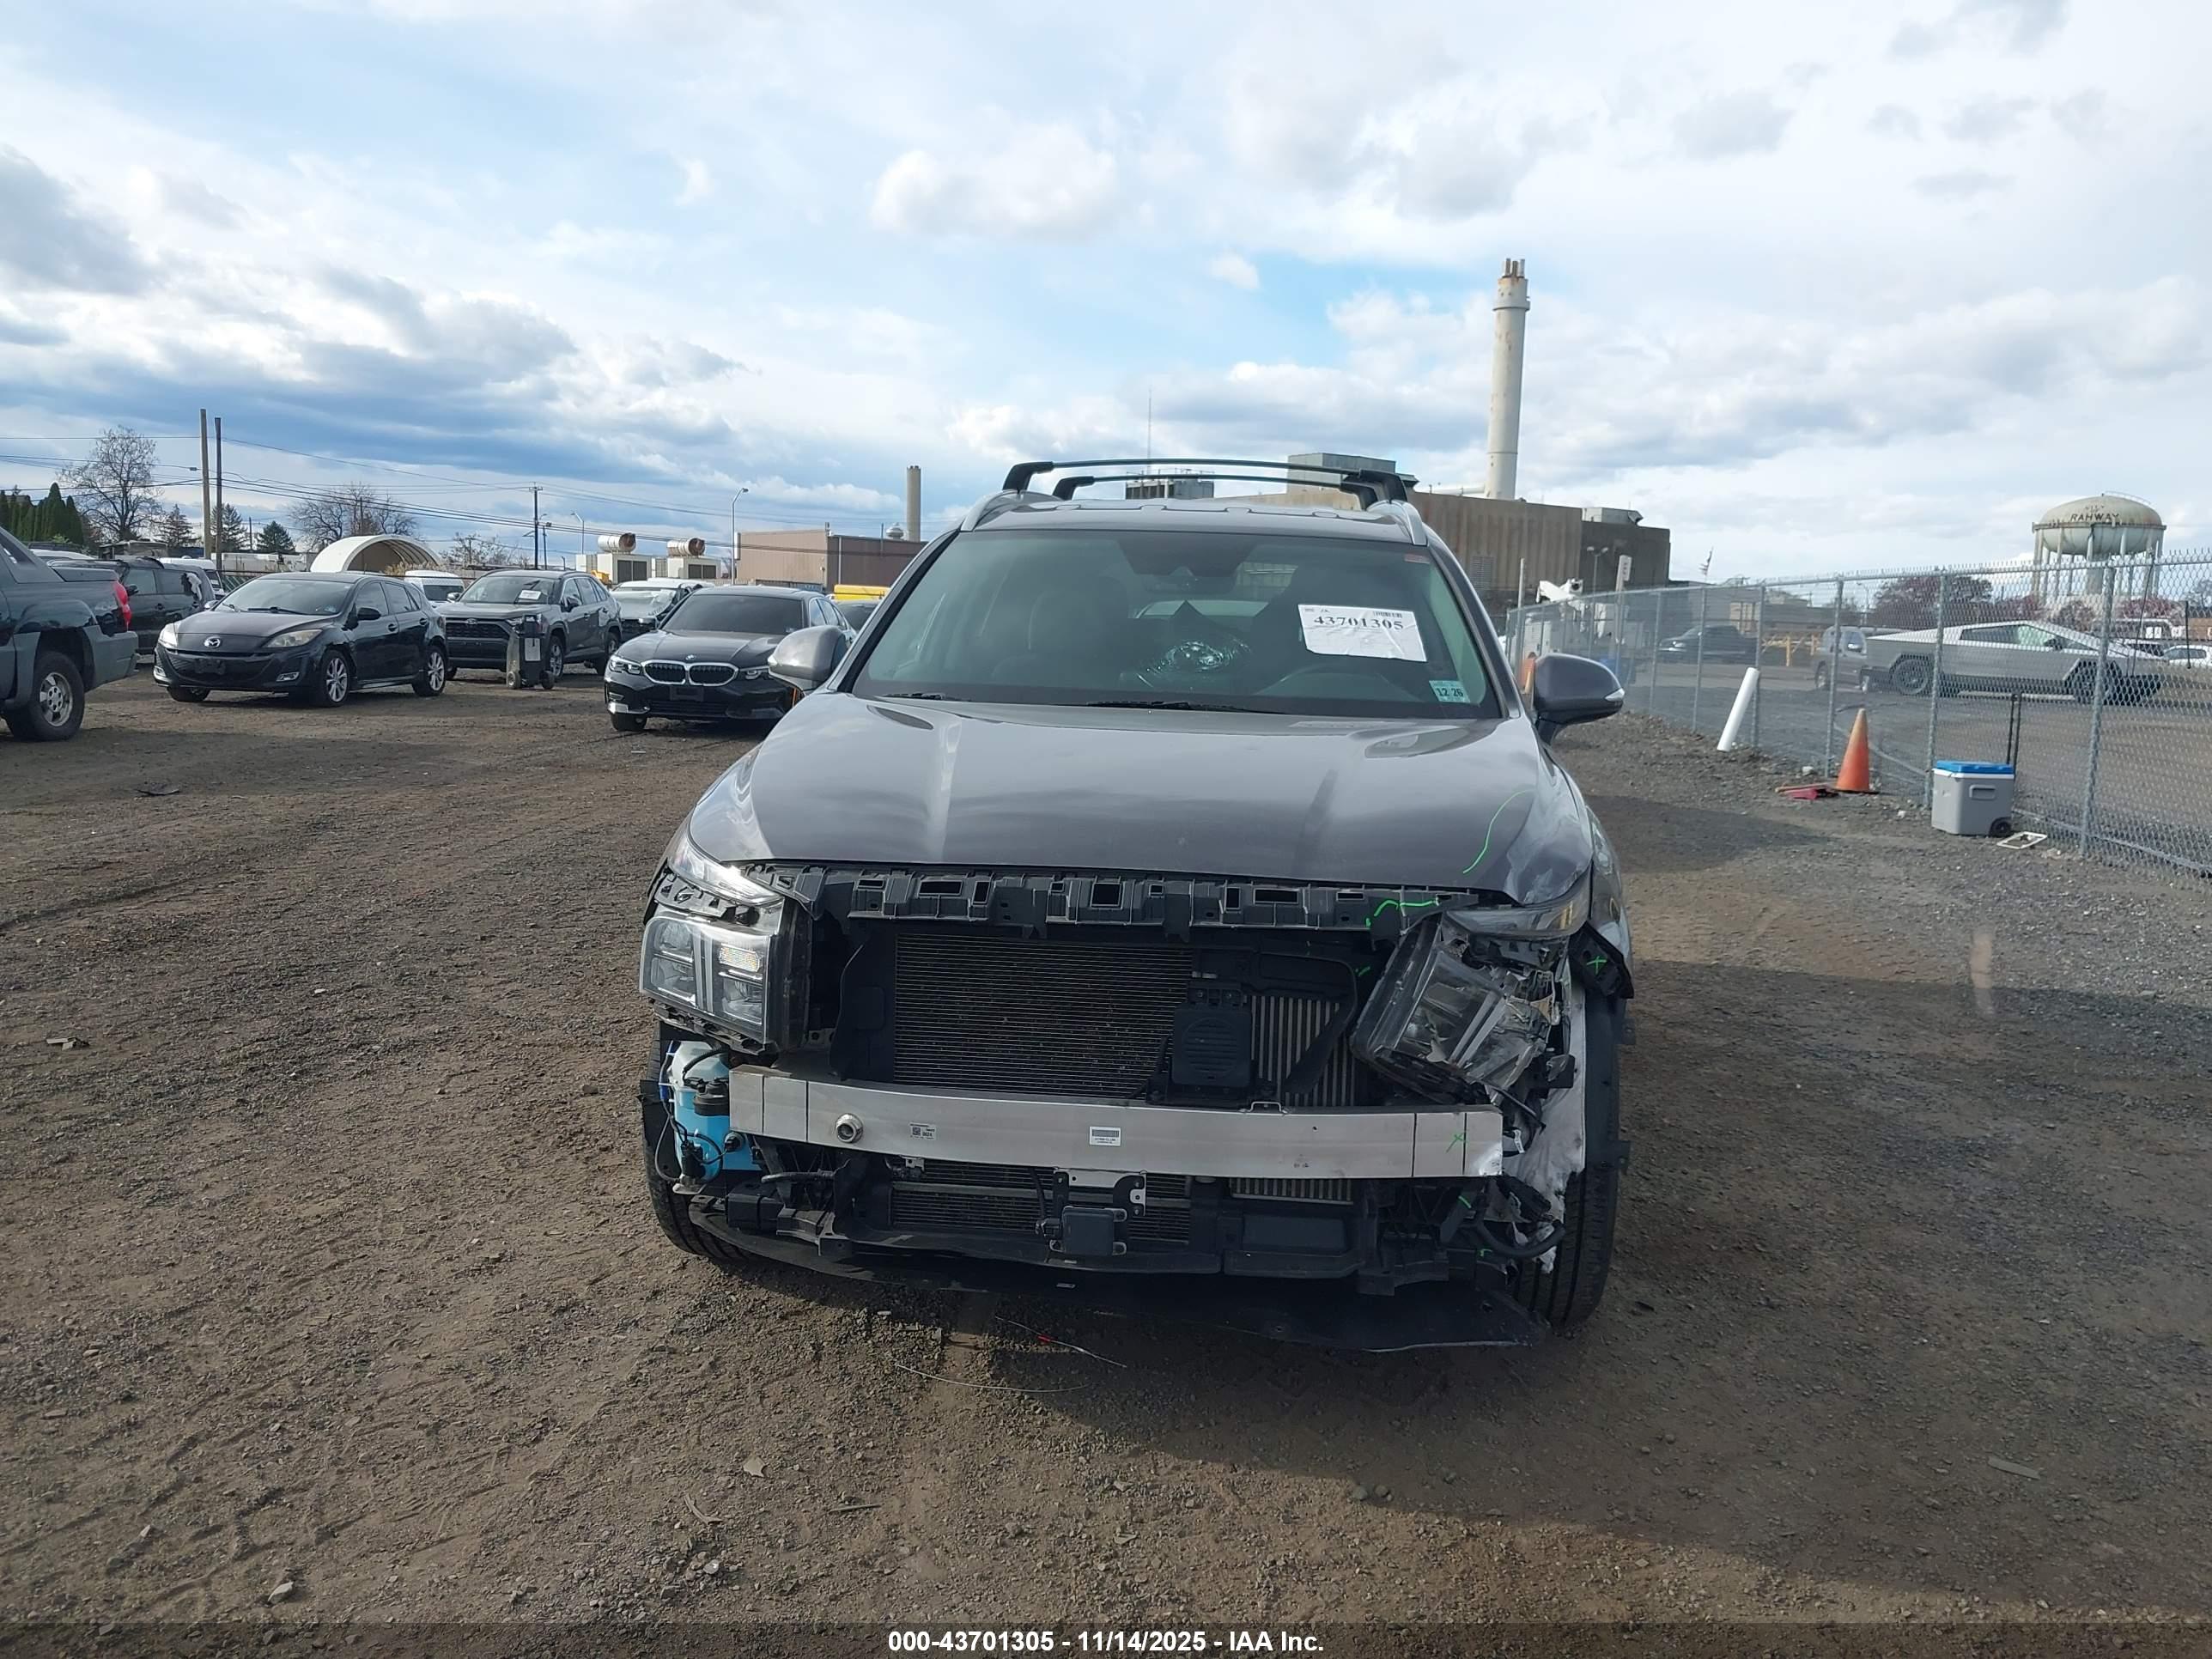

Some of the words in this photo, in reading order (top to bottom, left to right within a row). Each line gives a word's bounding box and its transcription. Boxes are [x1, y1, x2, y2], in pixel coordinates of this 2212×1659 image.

[2070, 513, 2119, 522] RAHWAY
[1314, 616, 1404, 631] 43701305
[1436, 688, 1450, 697] 12
